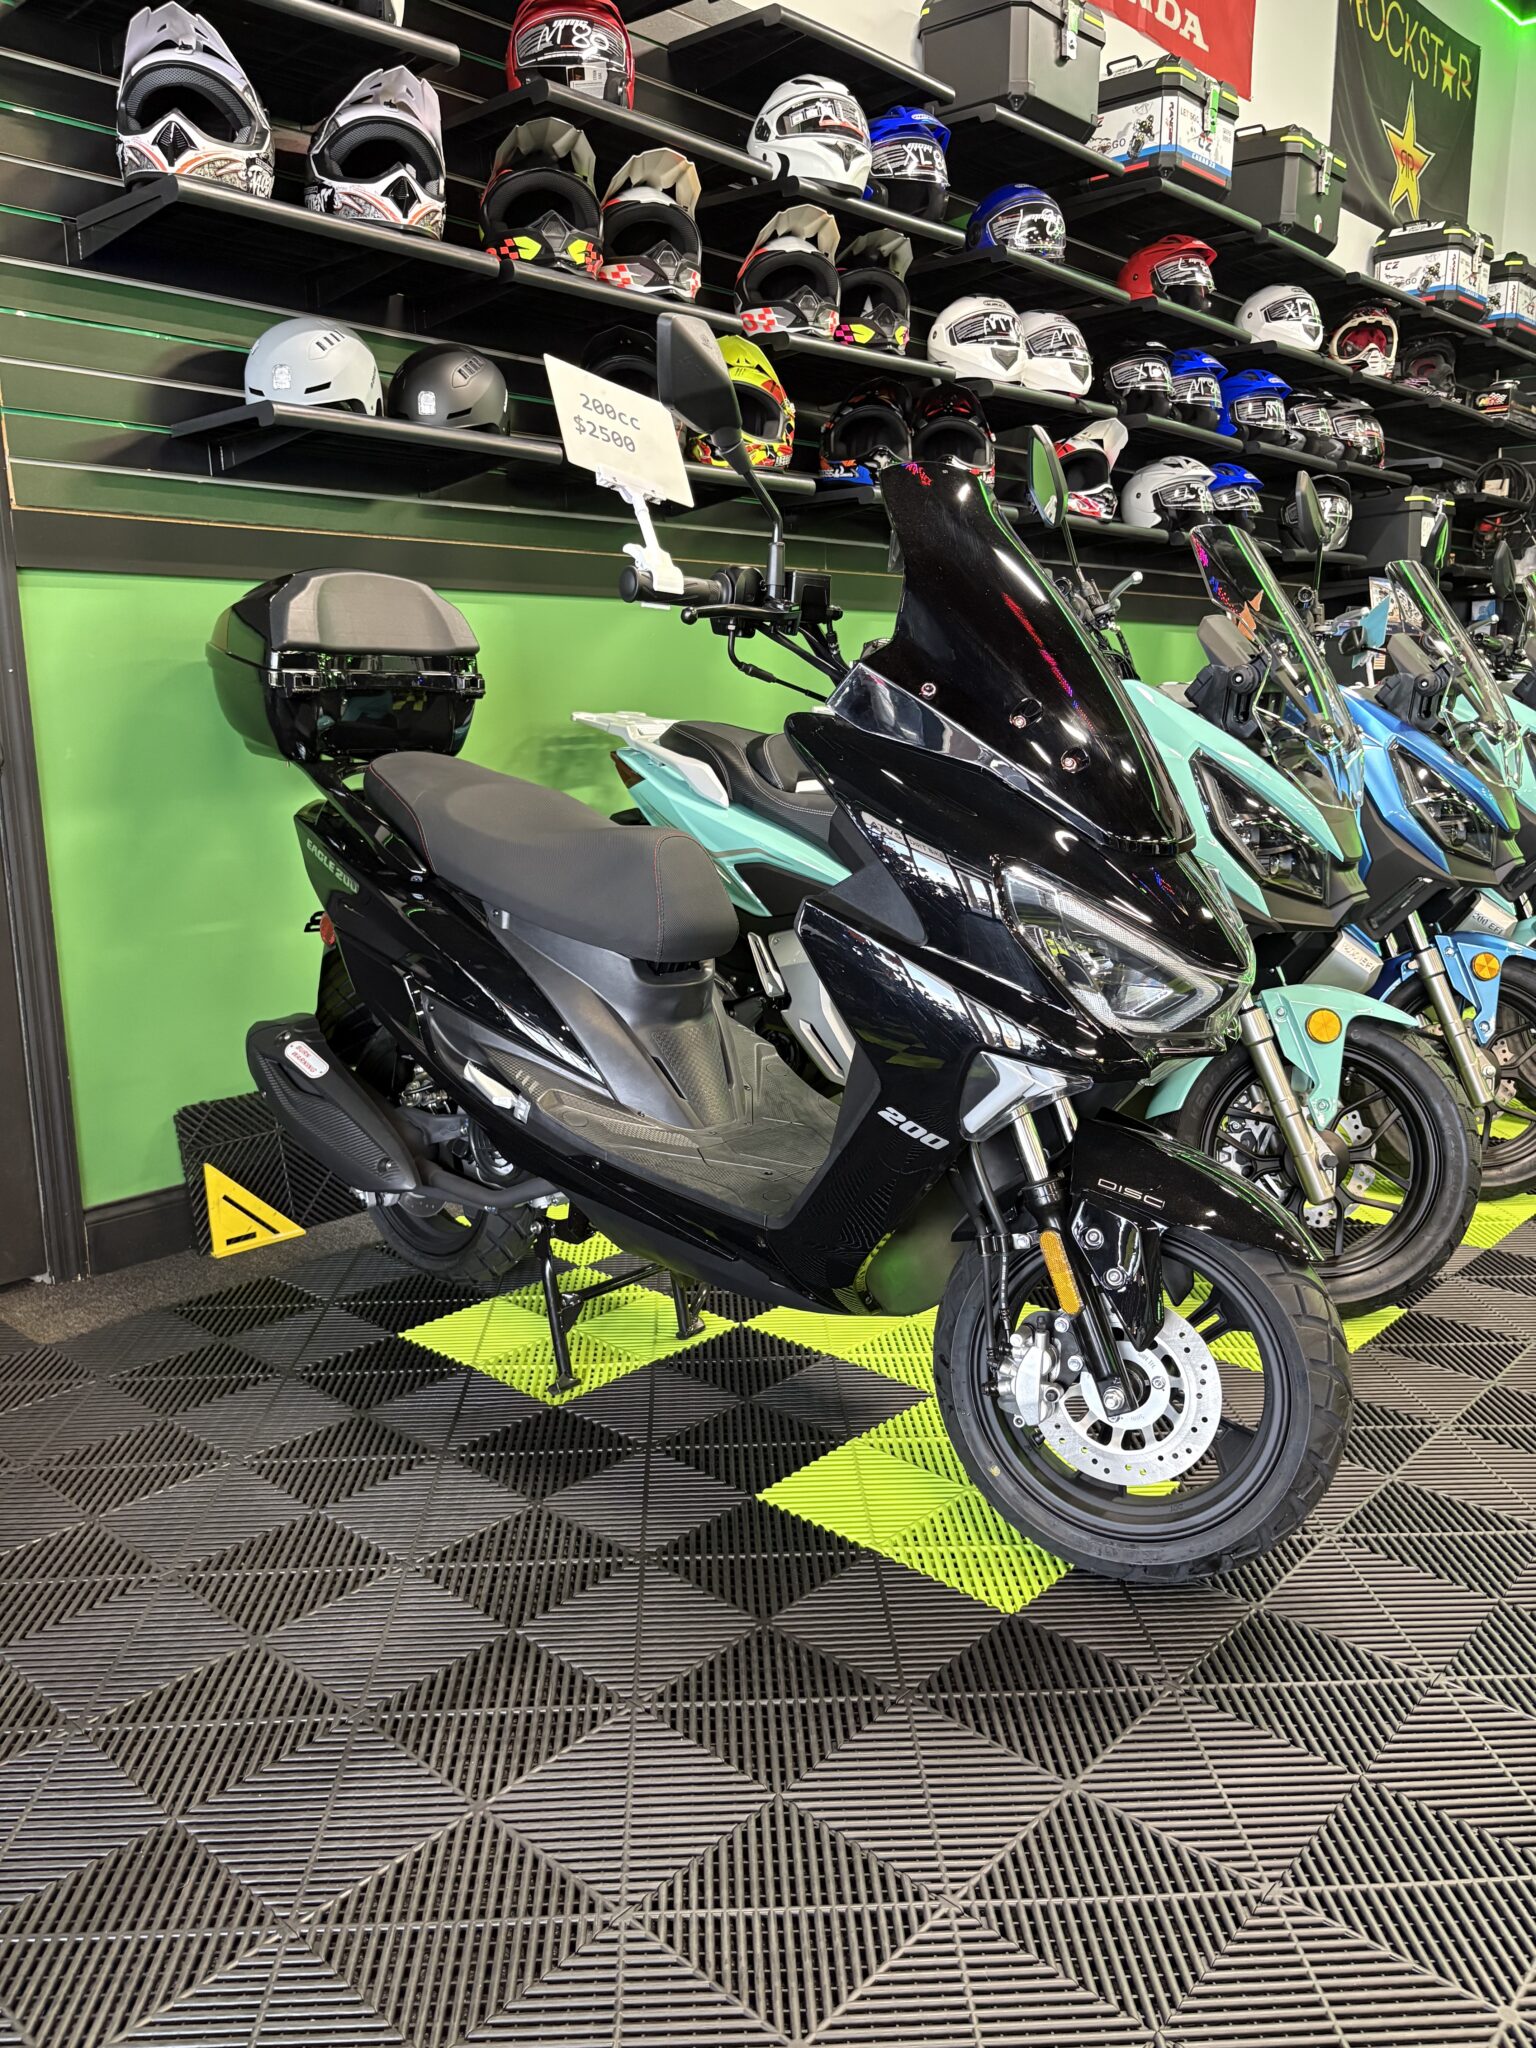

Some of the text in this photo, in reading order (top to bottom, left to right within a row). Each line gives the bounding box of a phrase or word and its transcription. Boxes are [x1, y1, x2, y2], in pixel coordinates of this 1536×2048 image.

[579, 393, 641, 431] 200cc
[573, 414, 636, 453] $2500
[306, 838, 360, 894] EAGLE 200
[877, 1106, 950, 1150] 200
[1098, 1178, 1166, 1210] DISC
